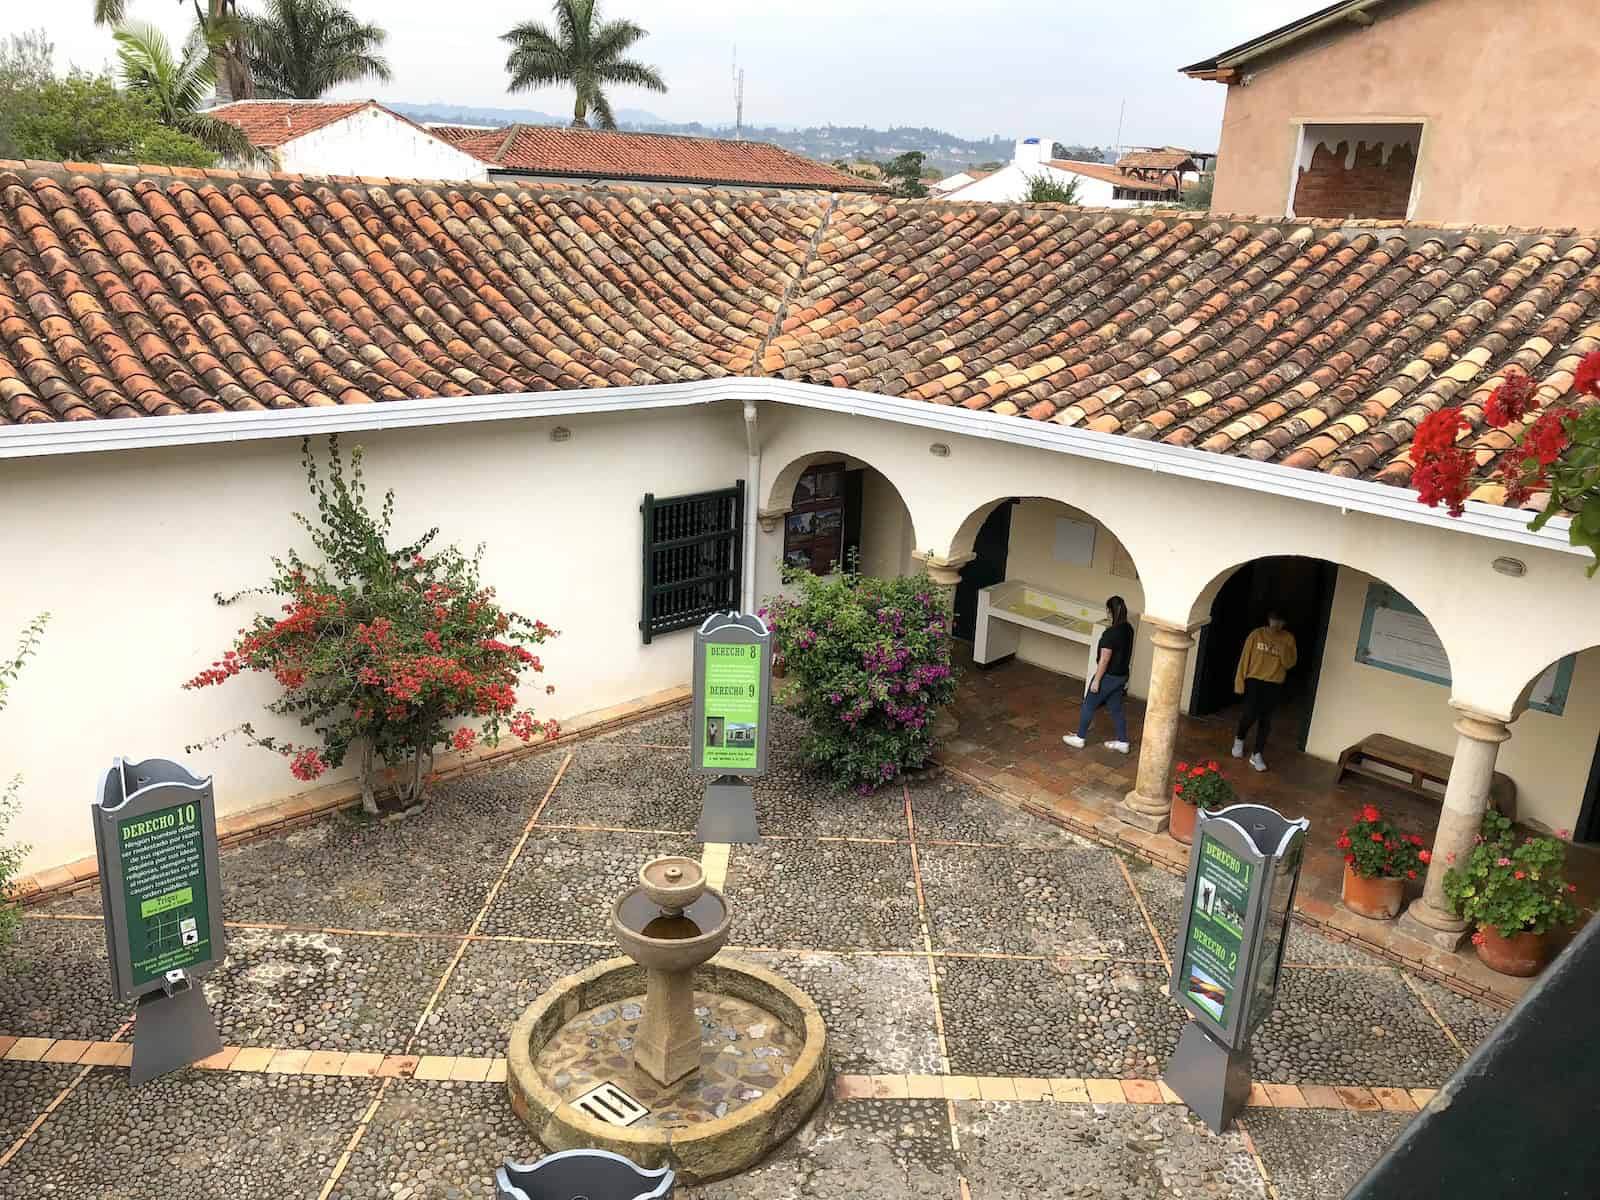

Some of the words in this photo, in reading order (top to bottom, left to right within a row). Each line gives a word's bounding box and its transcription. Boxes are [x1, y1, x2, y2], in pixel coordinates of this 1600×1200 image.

[711, 647, 745, 657] DERECHO
[750, 646, 757, 659] 8
[710, 686, 744, 696] DERECHO
[748, 684, 755, 698] 9
[122, 814, 175, 841] DERECHO
[177, 804, 196, 827] 10
[1206, 842, 1241, 874] DERECHO
[1244, 864, 1250, 884] 1
[1192, 927, 1226, 960] DERECHO
[1228, 952, 1237, 972] 2
